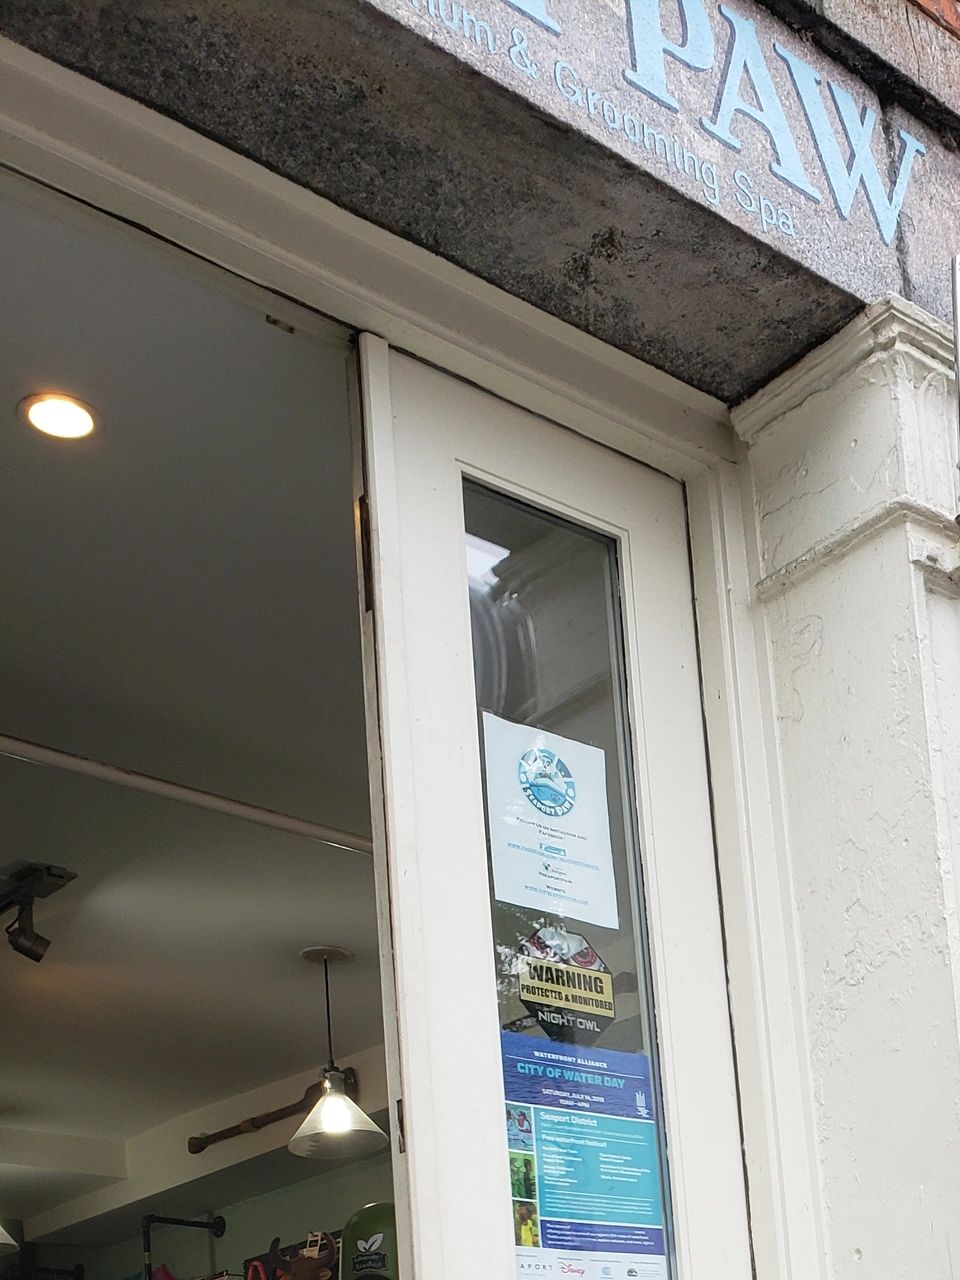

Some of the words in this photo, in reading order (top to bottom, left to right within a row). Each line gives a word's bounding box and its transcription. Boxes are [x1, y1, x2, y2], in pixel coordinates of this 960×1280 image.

[508, 27, 537, 79] &
[553, 59, 719, 203] Grooming
[731, 169, 797, 238] Spa
[622, 0, 926, 247] PAW
[526, 961, 604, 995] WARNING
[521, 983, 563, 1002] PROTECTED
[565, 993, 570, 1002] &
[571, 994, 613, 1011] MONITORED
[537, 1010, 575, 1027] NIGHT
[576, 1018, 600, 1032] OWL
[533, 1051, 577, 1064] WATERFRONT
[577, 1058, 608, 1068] ALLIANCE
[516, 1062, 545, 1076] CITY
[546, 1067, 561, 1079] OF
[563, 1069, 602, 1086] WATER
[604, 1075, 625, 1089] DAY
[539, 1111, 570, 1123] Seaport
[571, 1116, 598, 1127] District
